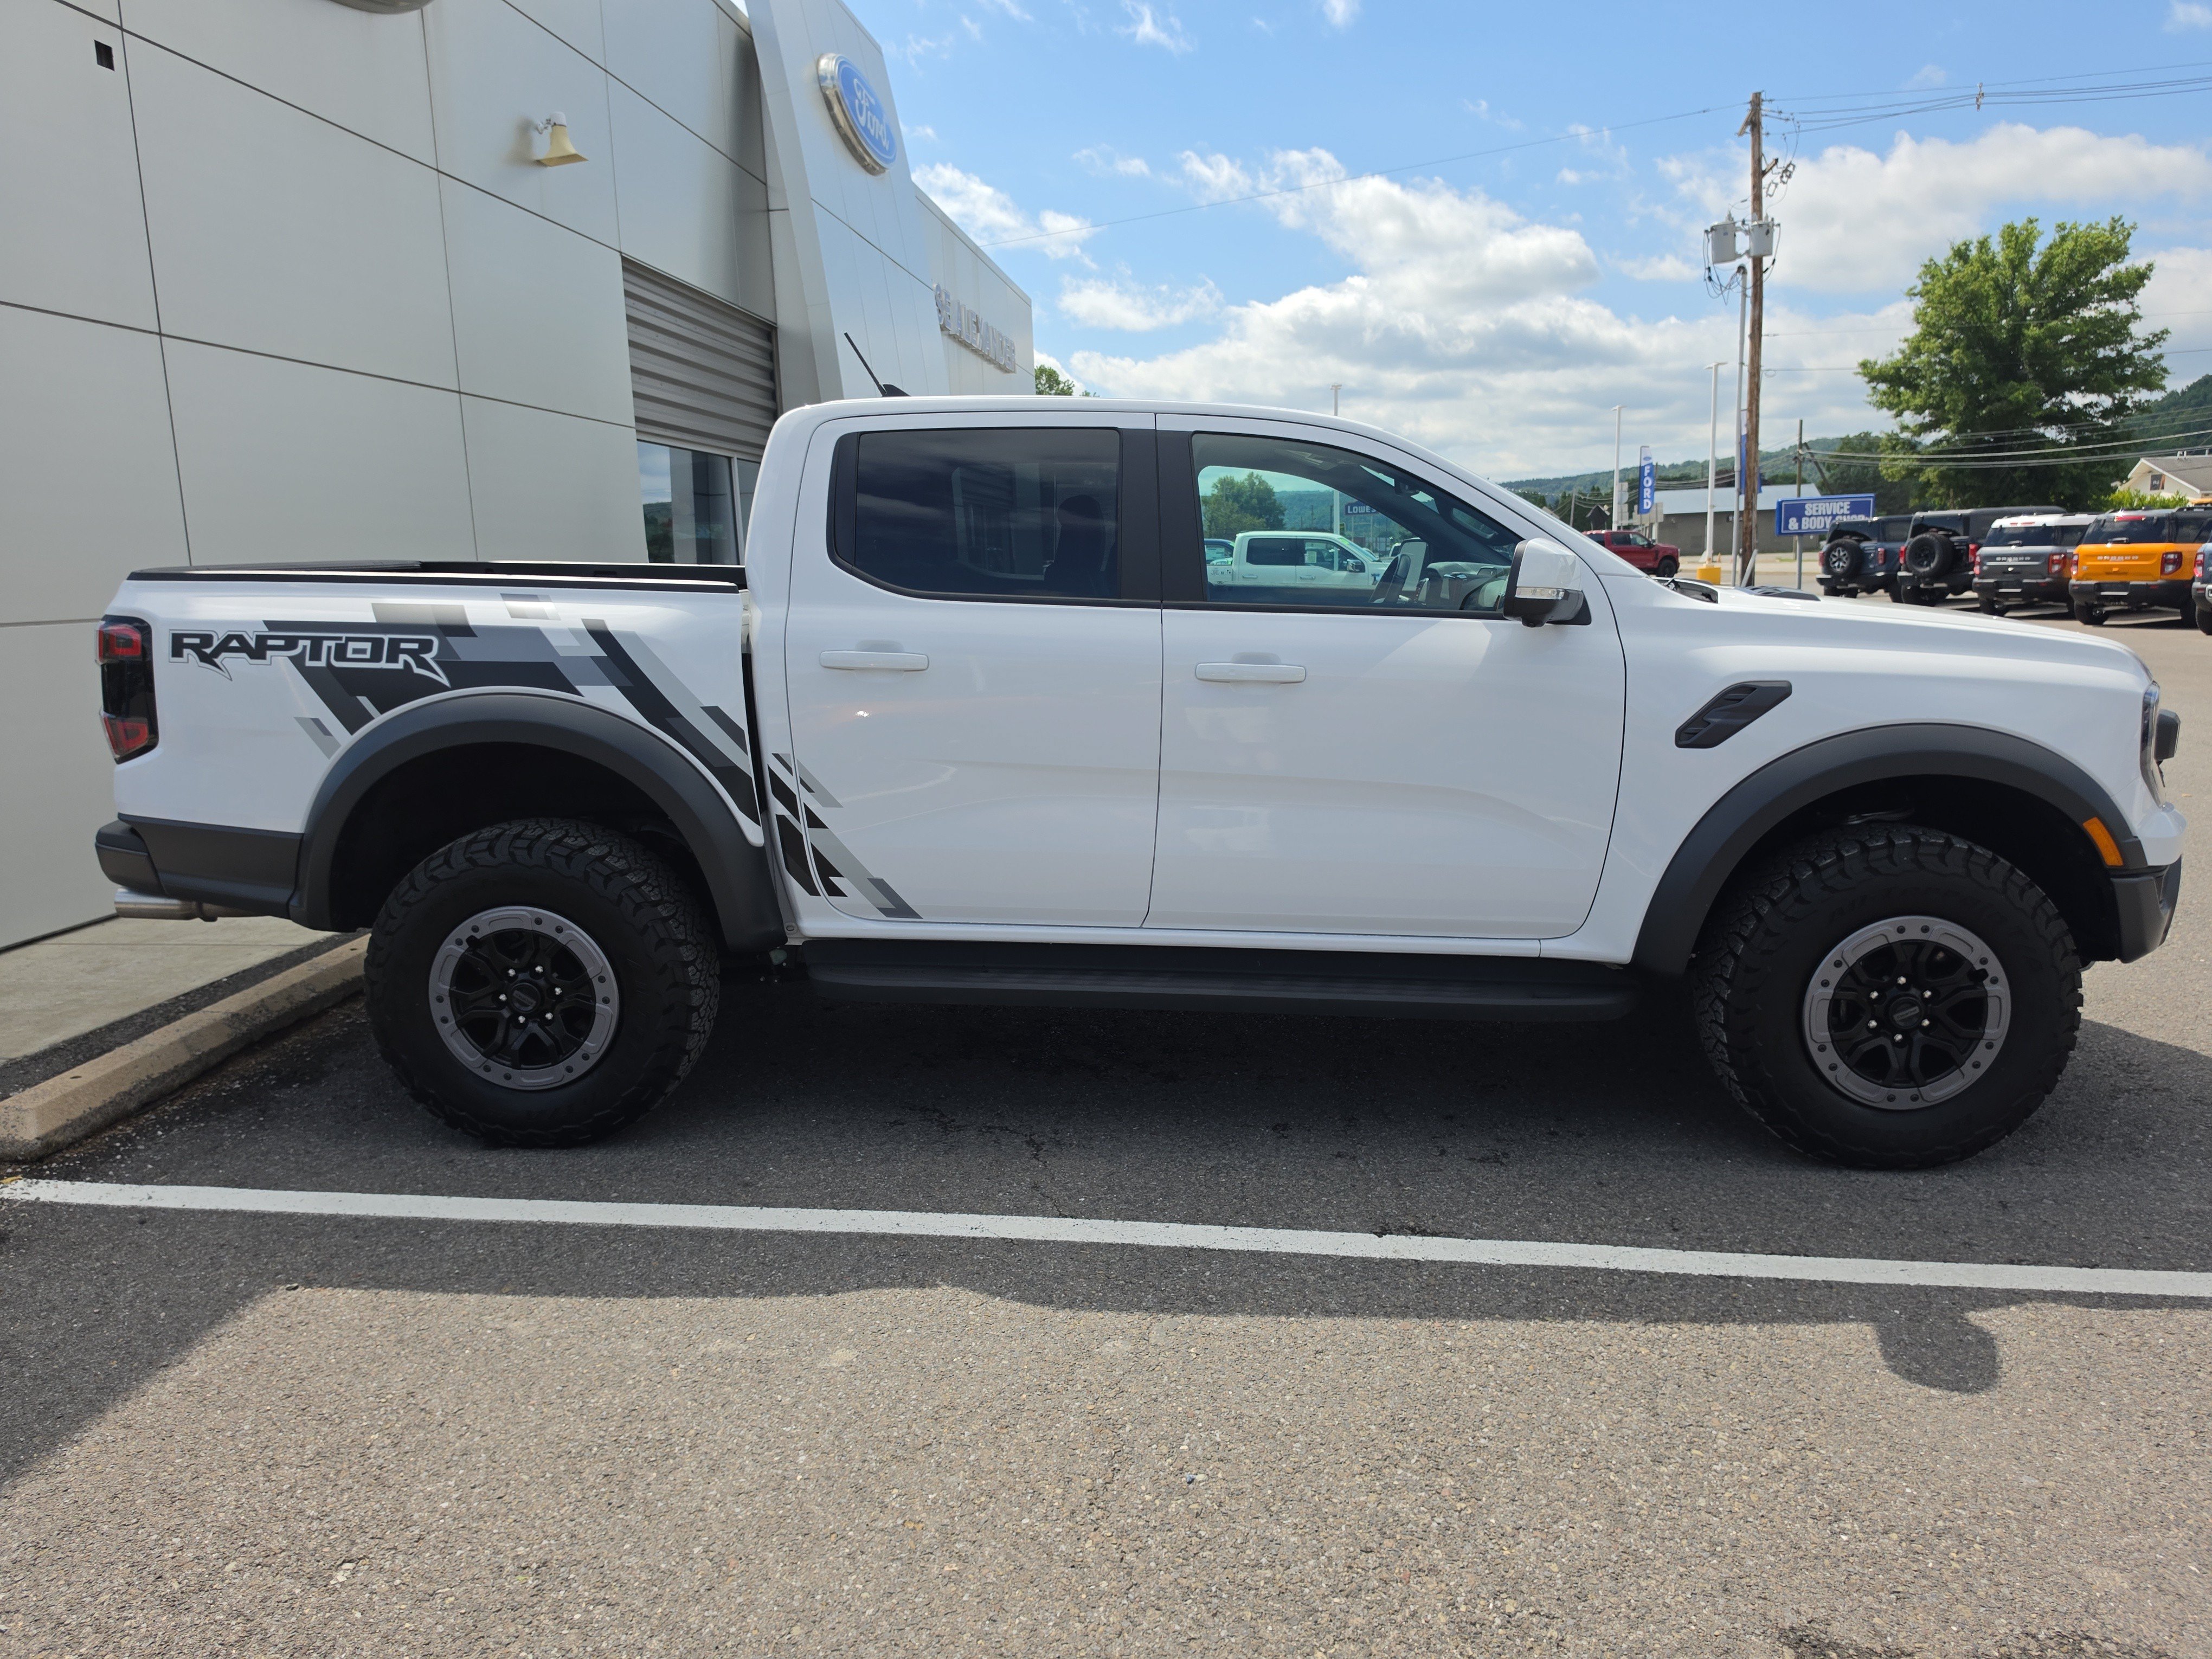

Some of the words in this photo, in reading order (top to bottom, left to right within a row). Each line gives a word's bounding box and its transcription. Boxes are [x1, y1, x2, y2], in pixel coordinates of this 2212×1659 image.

[854, 78, 890, 151] Ford
[935, 284, 953, 331] SE
[951, 299, 1016, 374] ALEXANDER
[1643, 465, 1652, 510] FORD
[1805, 501, 1850, 516] SERVICE
[1789, 517, 1799, 530] &
[1802, 516, 1833, 530] BODY
[169, 631, 452, 688] RAPTOR
